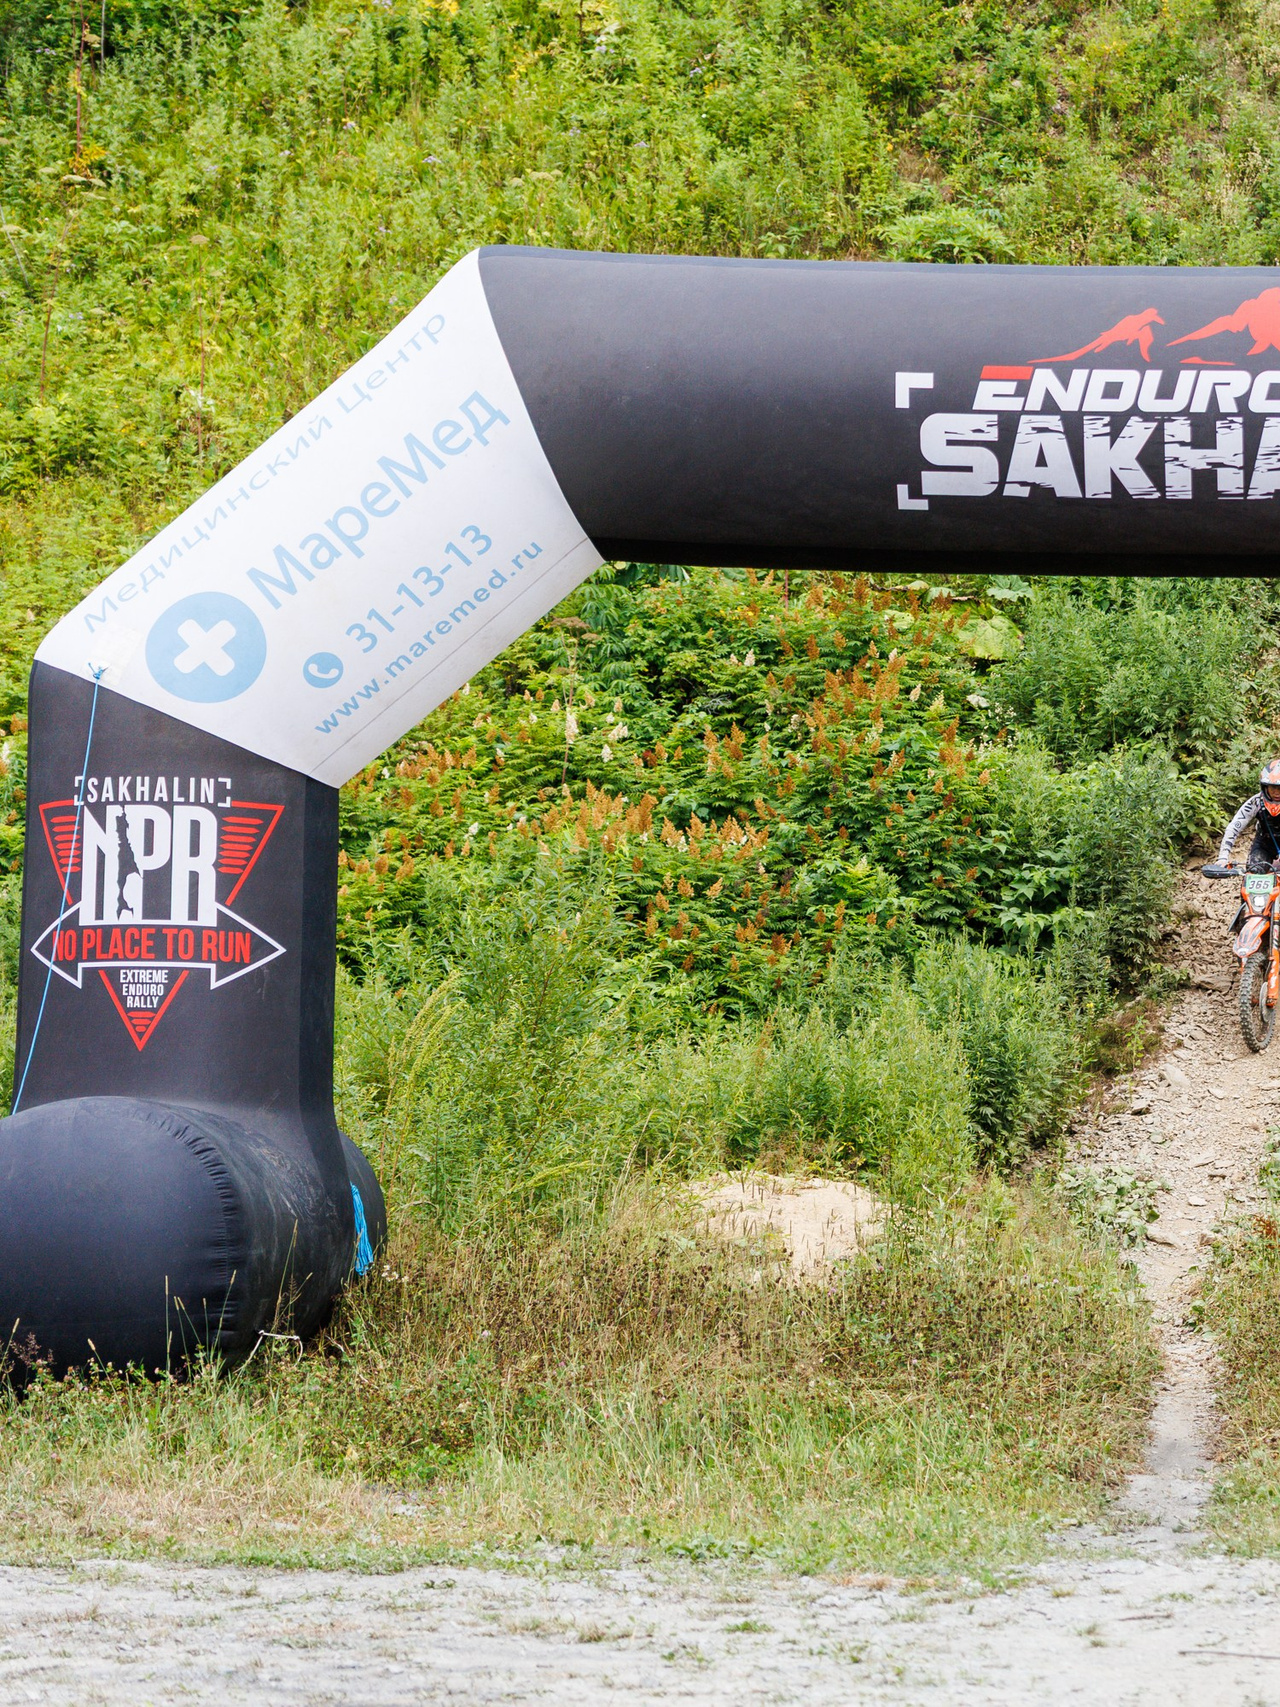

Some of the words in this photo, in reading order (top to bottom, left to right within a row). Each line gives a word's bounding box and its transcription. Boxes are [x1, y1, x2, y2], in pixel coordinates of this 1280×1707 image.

[83, 414, 334, 634] Медицинский
[338, 313, 446, 414] Центр
[246, 389, 512, 610] МареМед
[344, 522, 494, 655] 31-13-13
[314, 539, 545, 735] www.maremed.ru
[87, 776, 215, 804] SAKHALIN
[79, 804, 218, 927] NPR
[1248, 880, 1271, 890] 365
[52, 929, 77, 961] NO
[82, 928, 156, 960] PLACE
[162, 928, 195, 961] TO
[201, 930, 251, 964] RUN
[119, 969, 169, 984] EXTREME
[122, 984, 165, 996] ENDURO
[126, 996, 160, 1009] RALLY
